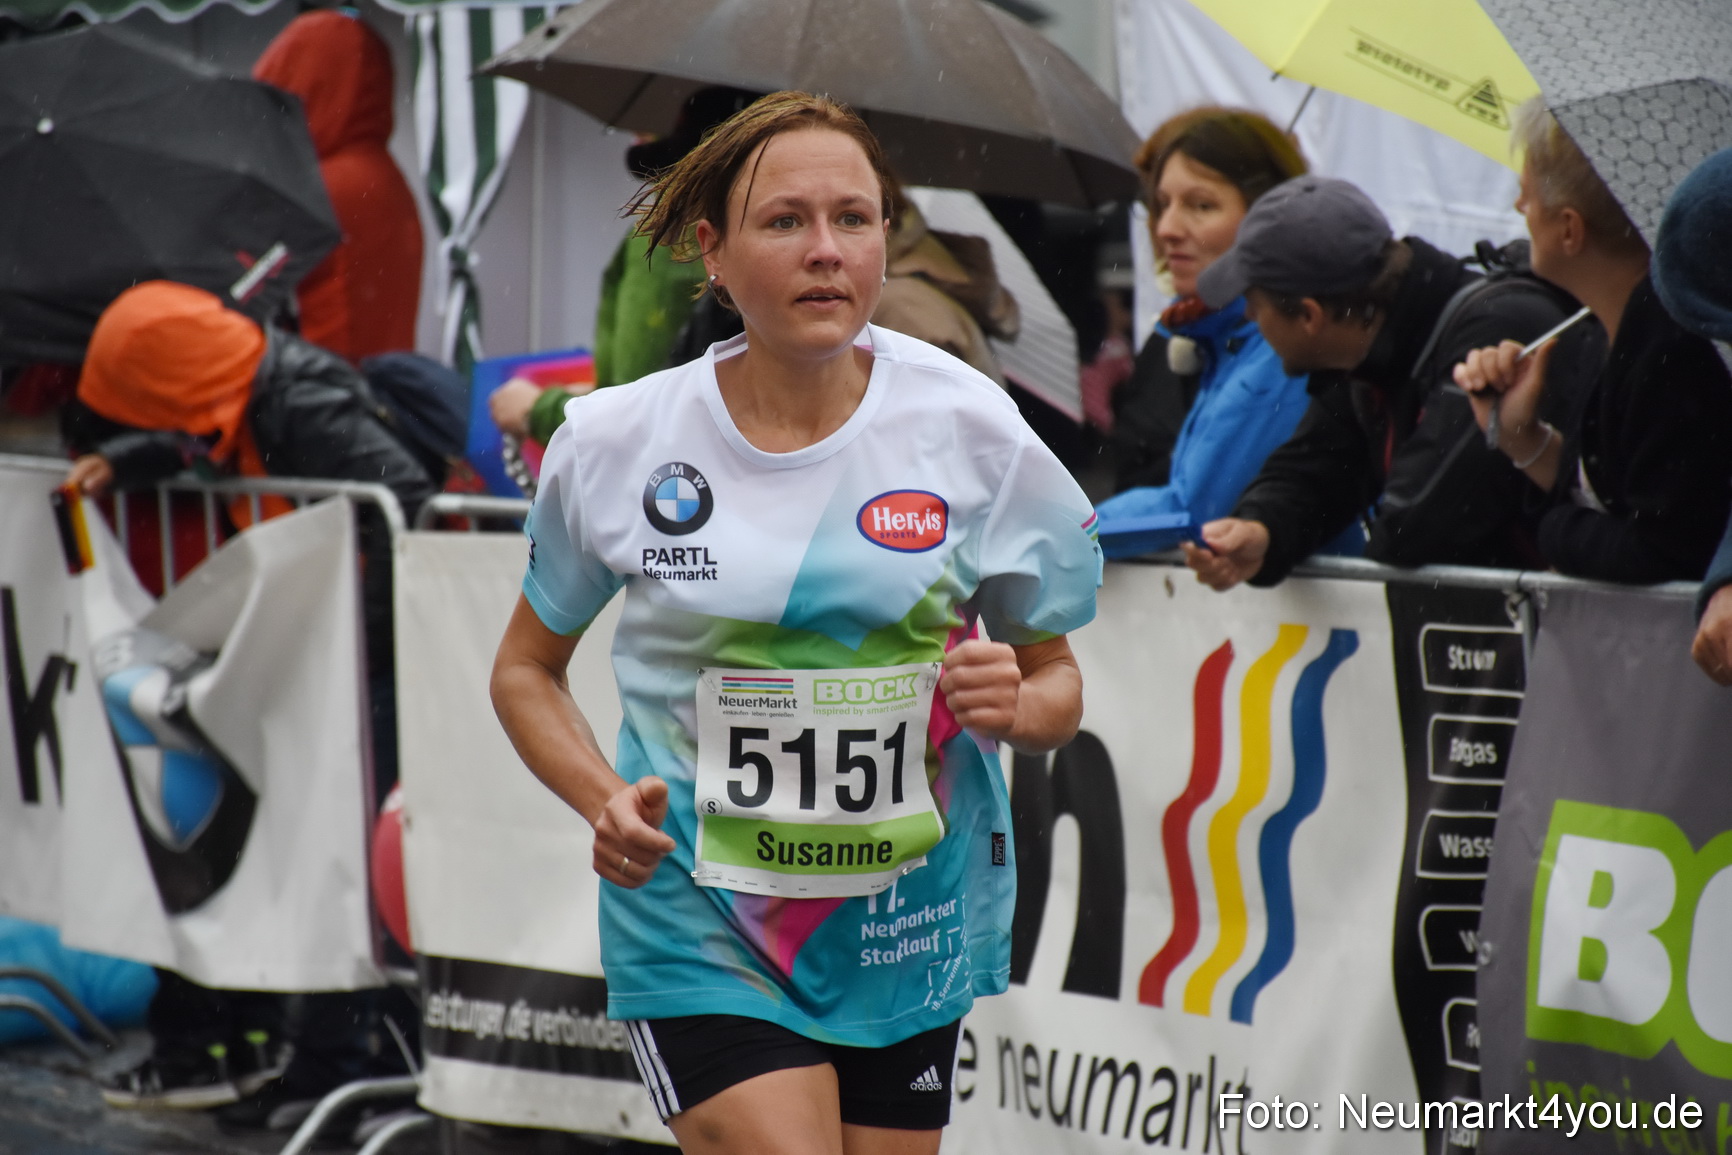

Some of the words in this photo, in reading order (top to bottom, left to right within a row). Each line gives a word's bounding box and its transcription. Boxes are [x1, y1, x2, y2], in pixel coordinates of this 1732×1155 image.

[649, 463, 706, 490] BMW
[872, 507, 942, 535] Hervis
[879, 531, 917, 539] SPORTS
[642, 547, 717, 566] PARTL
[642, 567, 718, 581] Neumarkt
[813, 672, 919, 705] BOCK
[718, 695, 798, 709] NeuerMarkt
[813, 706, 850, 716] inspired
[853, 706, 864, 716] by
[866, 705, 890, 715] smart
[890, 700, 918, 712] concepts
[727, 721, 907, 813] 5151
[707, 801, 716, 814] S
[756, 831, 893, 866] Susanne
[861, 898, 957, 941] Neumarkter
[938, 950, 964, 1000] September
[910, 1082, 942, 1091] adidas
